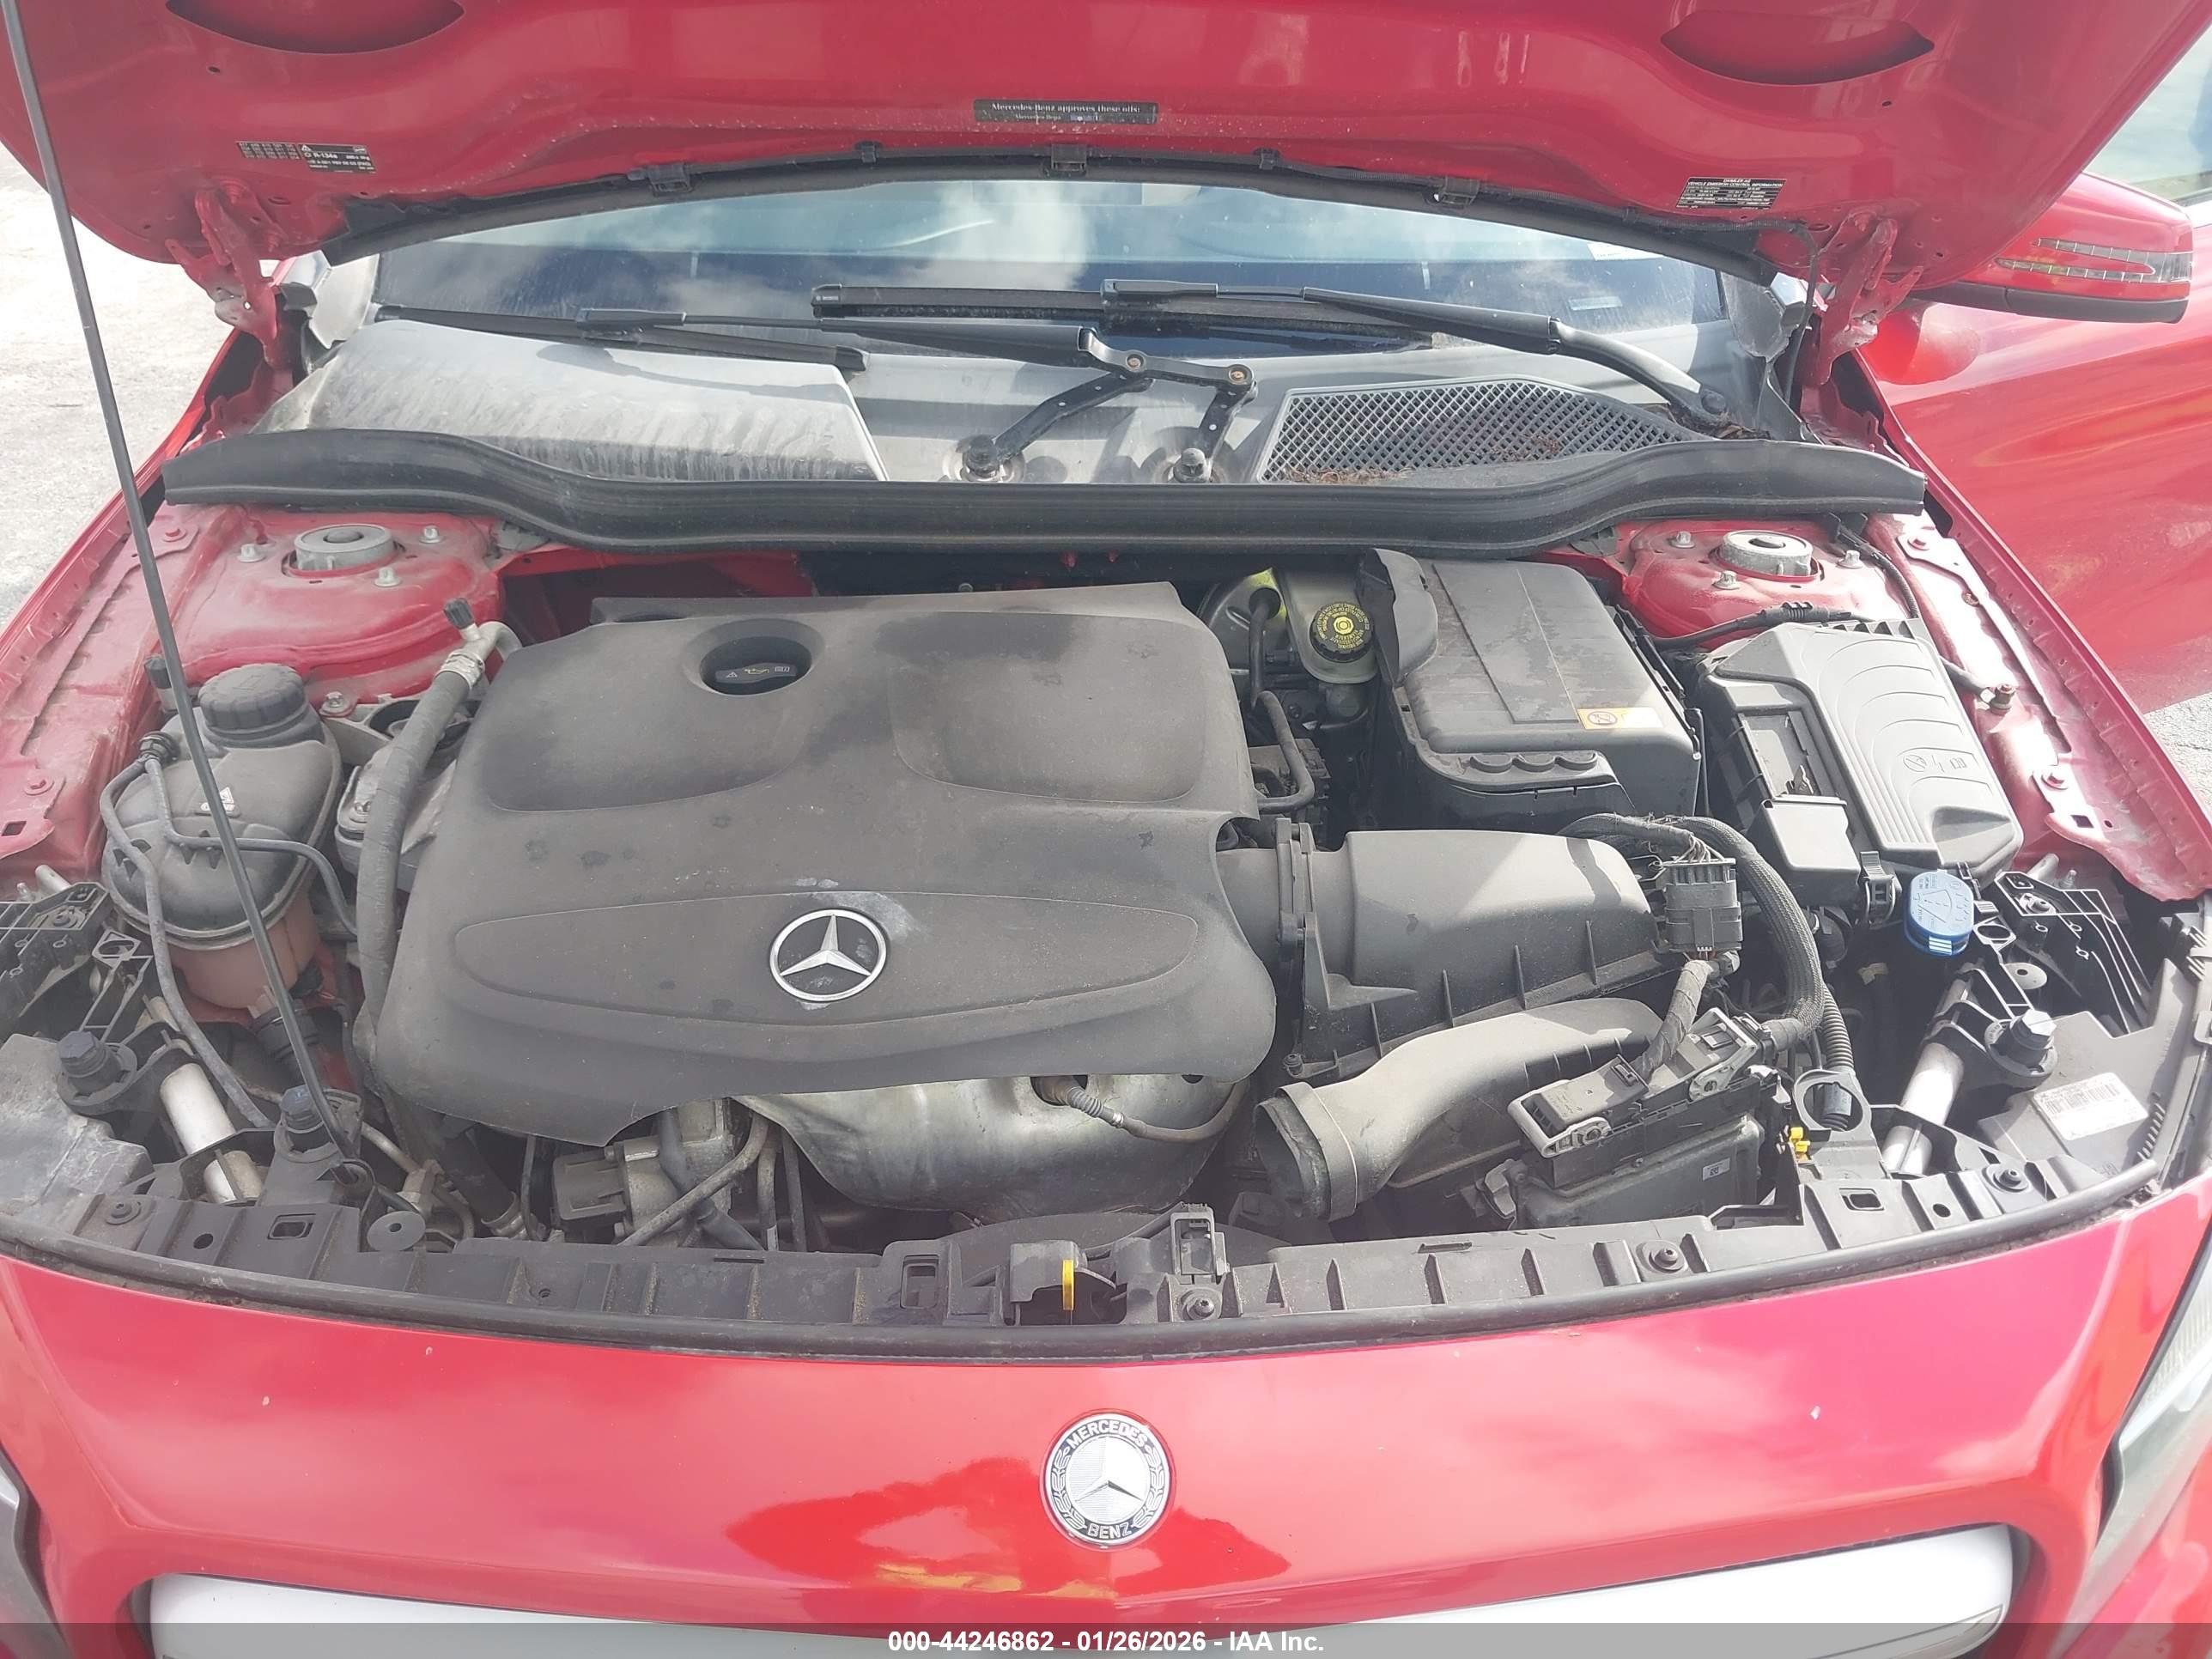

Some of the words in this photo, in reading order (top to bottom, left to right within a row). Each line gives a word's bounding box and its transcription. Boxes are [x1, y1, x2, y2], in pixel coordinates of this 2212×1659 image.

[1057, 105, 1095, 113] approves
[1097, 103, 1121, 112] these
[1066, 1419, 1147, 1449] MERCEDES
[1087, 1522, 1132, 1539] BENZ
